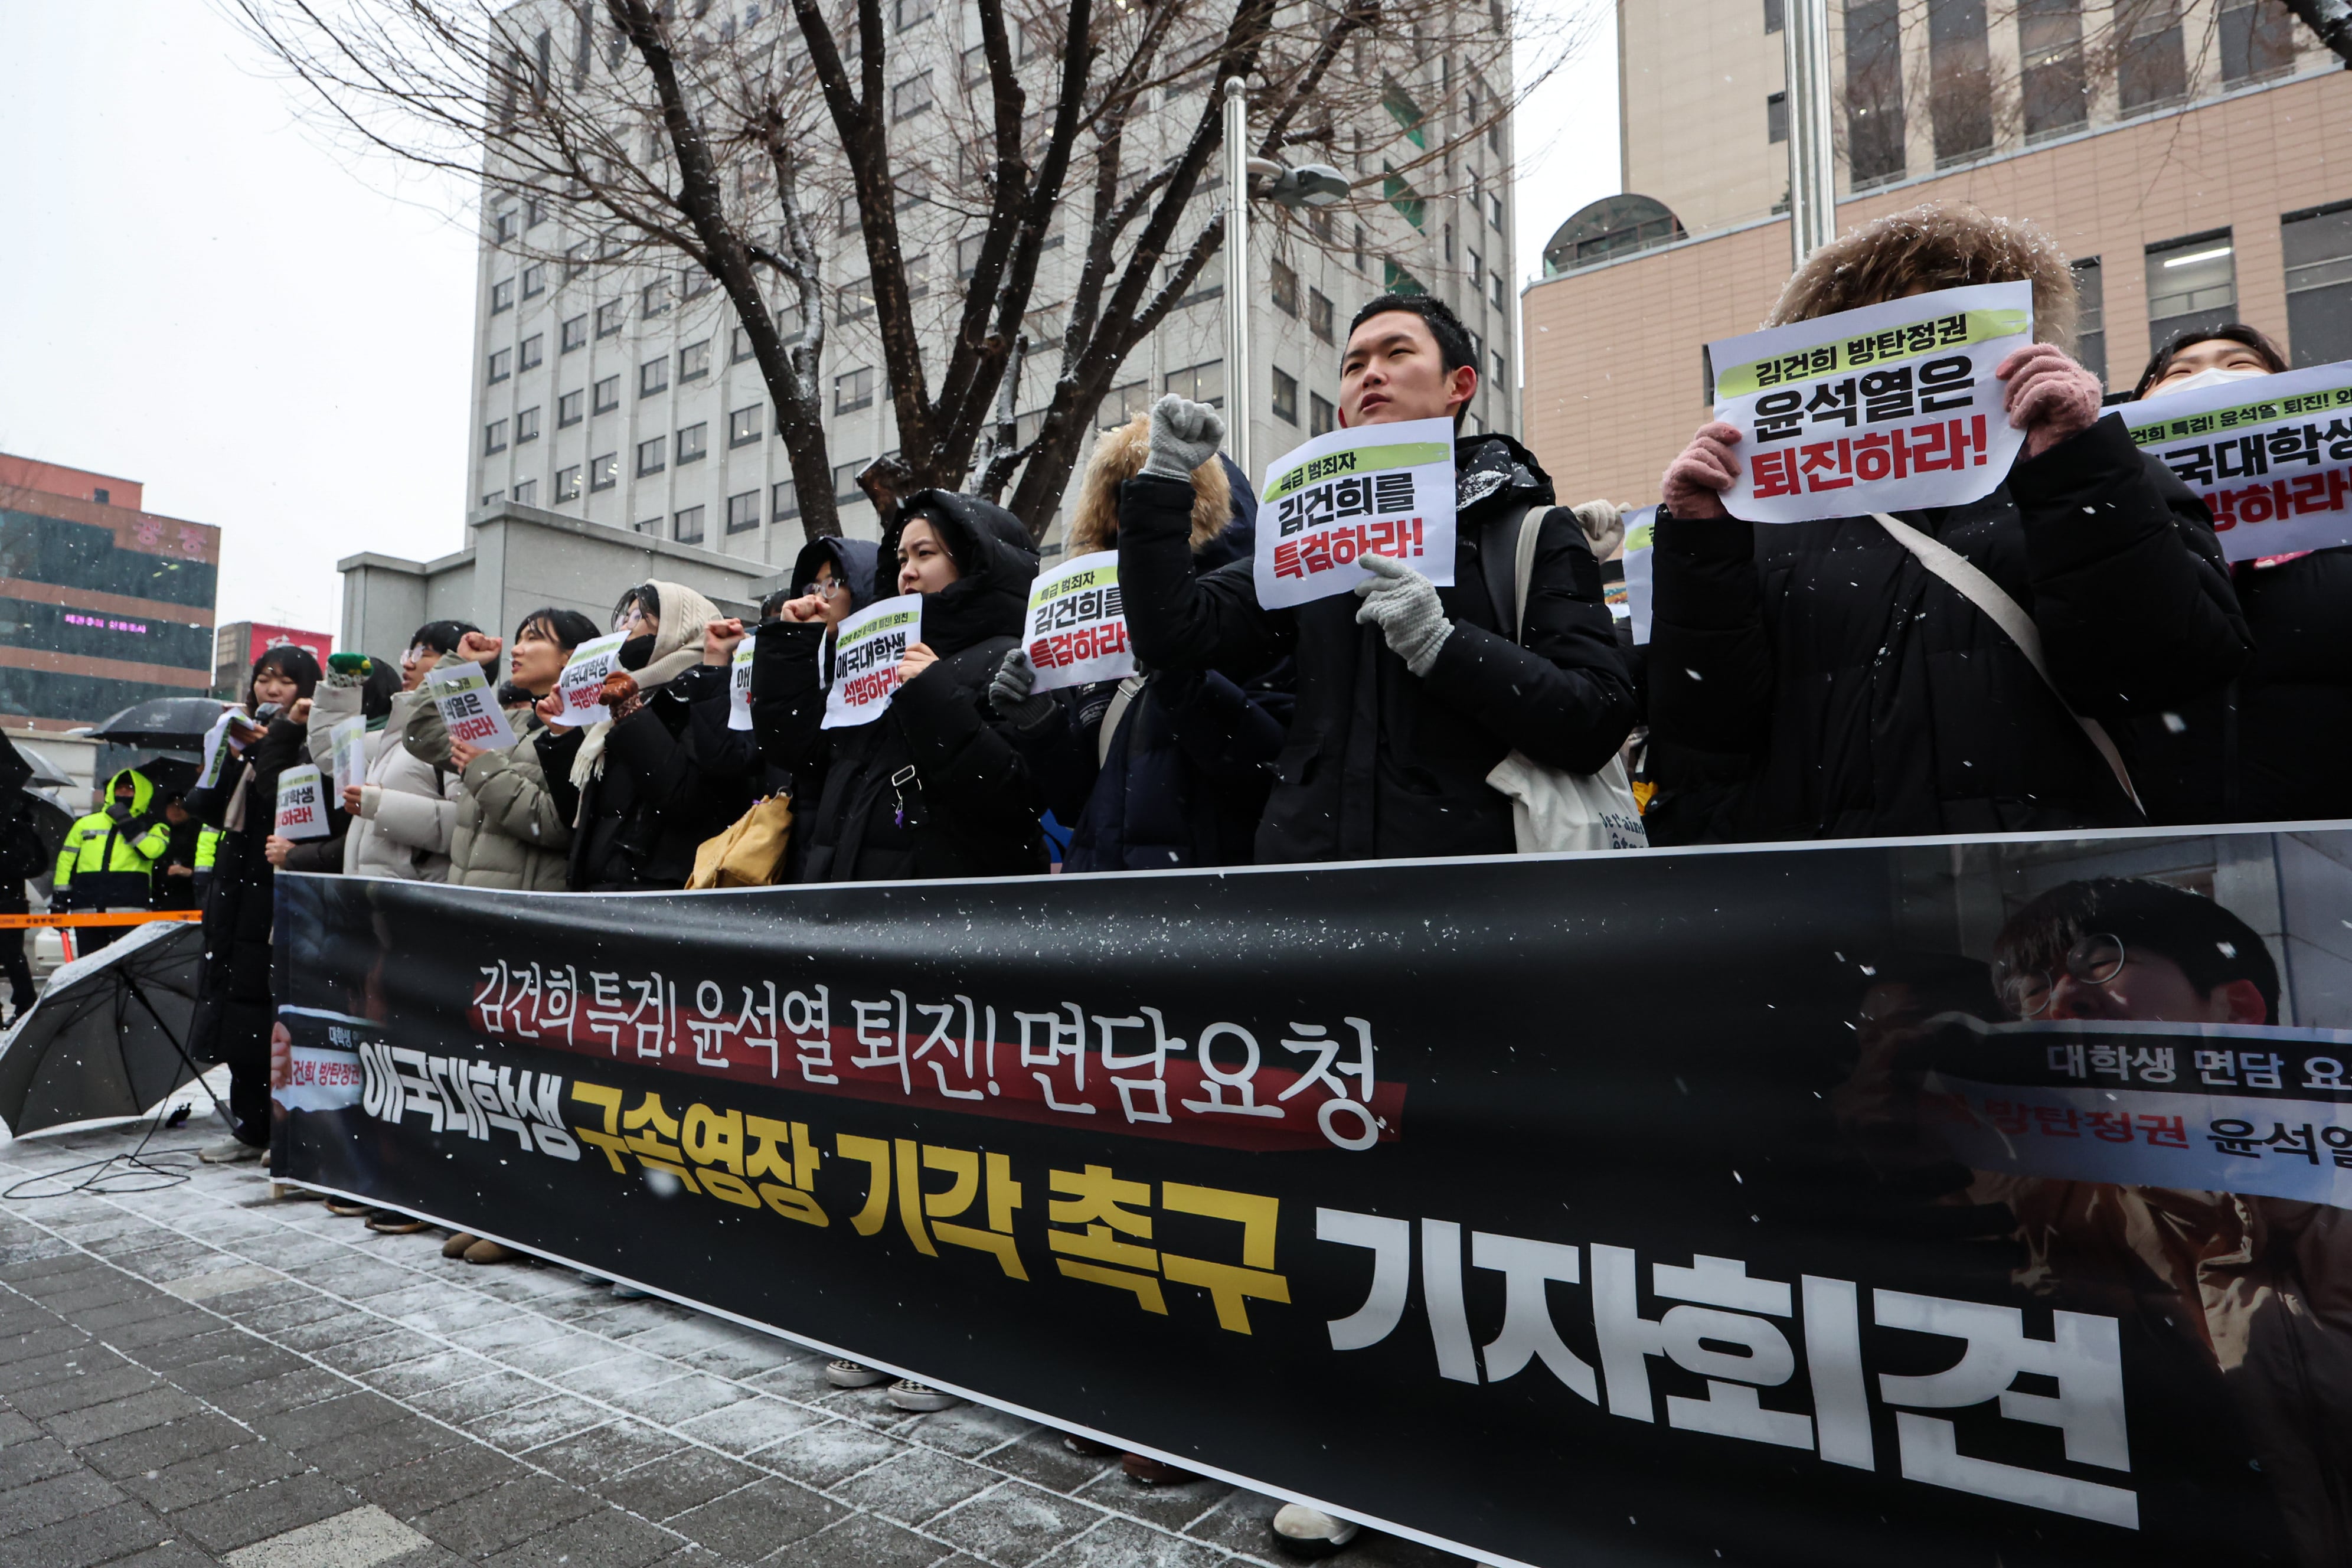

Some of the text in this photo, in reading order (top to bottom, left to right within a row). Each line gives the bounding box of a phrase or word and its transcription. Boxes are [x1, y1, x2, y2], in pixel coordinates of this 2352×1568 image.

[1756, 313, 1968, 387] 김건희 방탄정권
[1753, 355, 1975, 444] 윤석열은
[2130, 388, 2352, 446] 건희 특검! 윤석열 퇴진! 외
[1279, 452, 1357, 491] 특급 범죄자
[1750, 413, 1988, 499] 퇴진하라!
[2155, 418, 2352, 486] 국대학
[1278, 472, 1415, 538] 김건희를
[2201, 466, 2352, 533] 방하라
[1273, 517, 1423, 579] 특검하라!
[1034, 586, 1123, 636] 김건희를
[1040, 571, 1096, 602] 특급 범죄자
[894, 612, 909, 624] 외친
[835, 632, 906, 679] 애국대학생
[438, 692, 484, 720] 석열은
[844, 665, 902, 707] 석방하라
[1611, 813, 1645, 835] t'aim
[328, 1026, 352, 1048] 대학생
[473, 959, 578, 1046] 김건희
[586, 971, 677, 1058] 특검!
[686, 979, 839, 1085] 윤석열
[850, 988, 1001, 1101] 퇴진!
[319, 1061, 360, 1086] 방탄정권
[2047, 1044, 2352, 1091] 대학생 면담 요
[1984, 1098, 2190, 1150] 방탄정권
[358, 1041, 2140, 1531] 애국대학생 구속영장 기각 촉구 기자회견
